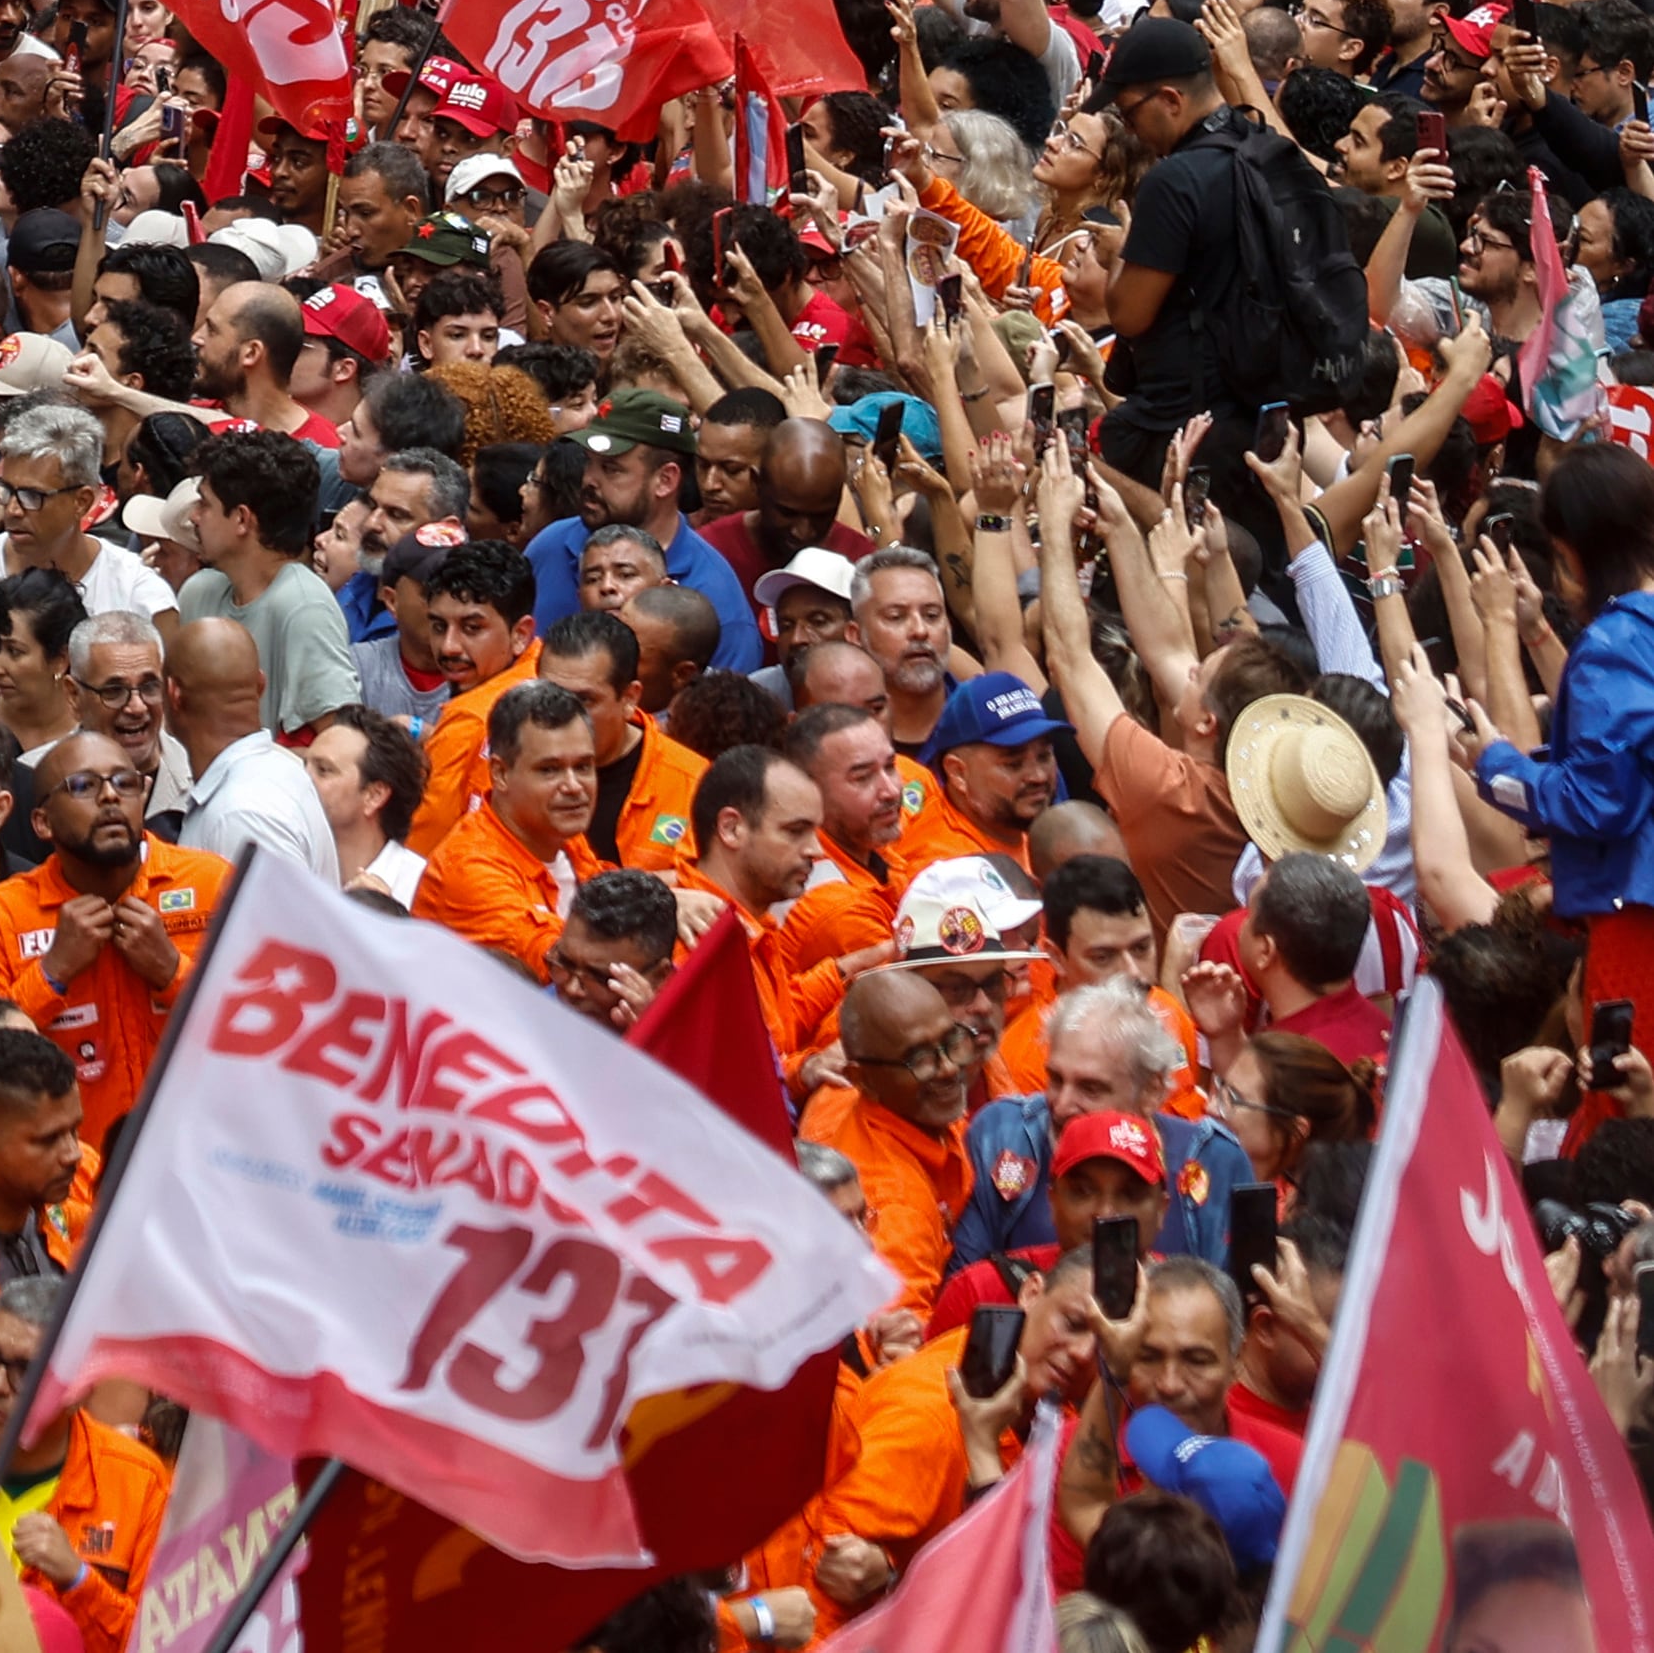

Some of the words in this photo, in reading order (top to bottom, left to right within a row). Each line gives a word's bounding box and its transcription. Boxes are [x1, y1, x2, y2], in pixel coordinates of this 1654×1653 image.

[452, 81, 488, 101] Lula
[206, 935, 775, 1306] BENEDITA
[399, 1223, 682, 1452] 131
